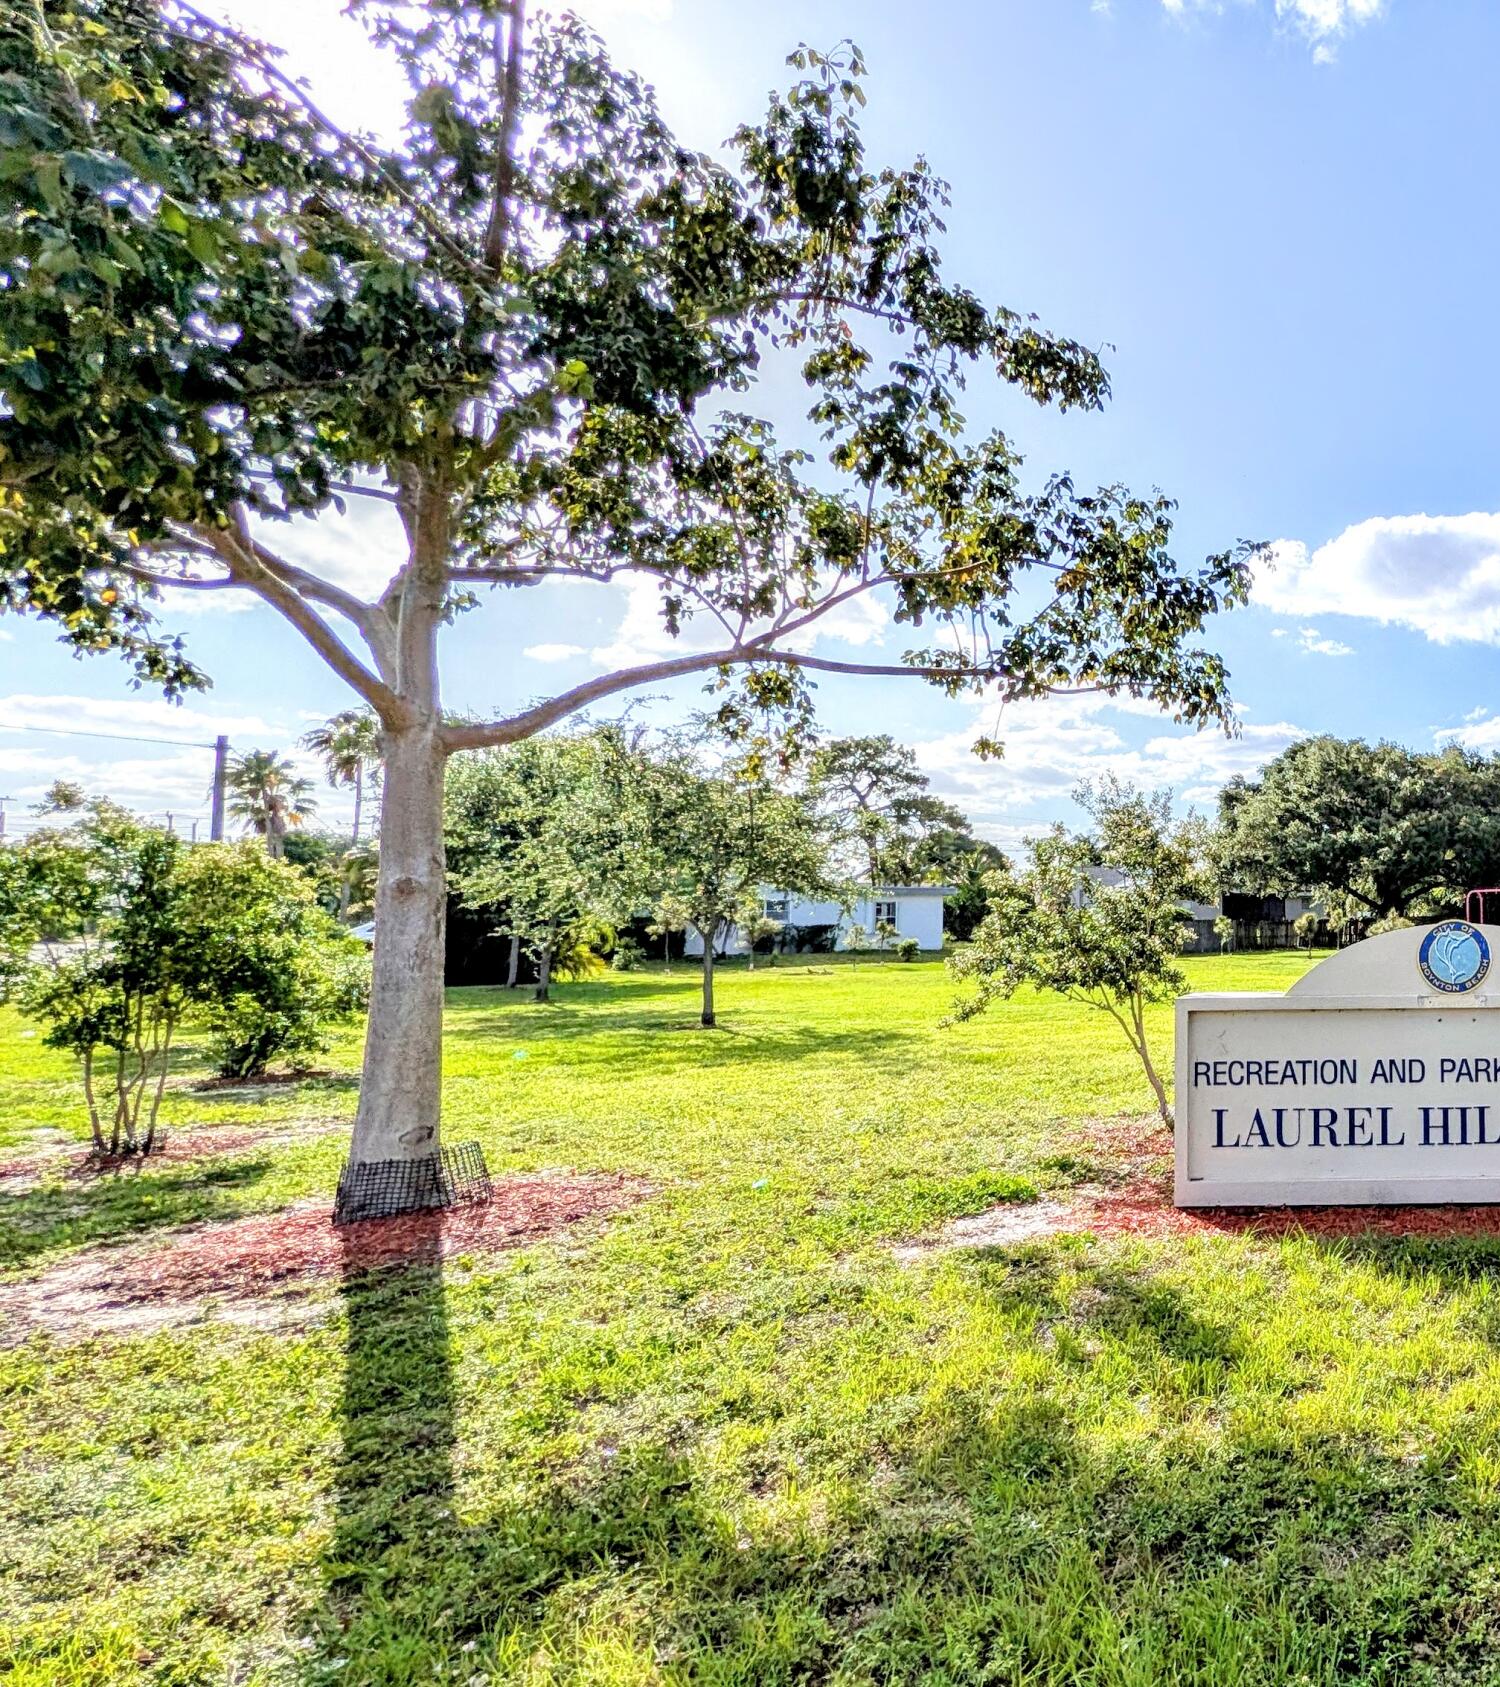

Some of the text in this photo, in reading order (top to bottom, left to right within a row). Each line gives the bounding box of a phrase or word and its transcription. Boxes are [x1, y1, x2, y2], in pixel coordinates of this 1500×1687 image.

[1432, 923, 1475, 937] CITY OF
[1420, 959, 1489, 991] BOYNTON BEACH
[1194, 1059, 1356, 1088] RECREATION
[1371, 1059, 1425, 1083] AND
[1212, 1107, 1405, 1148] LAUREL
